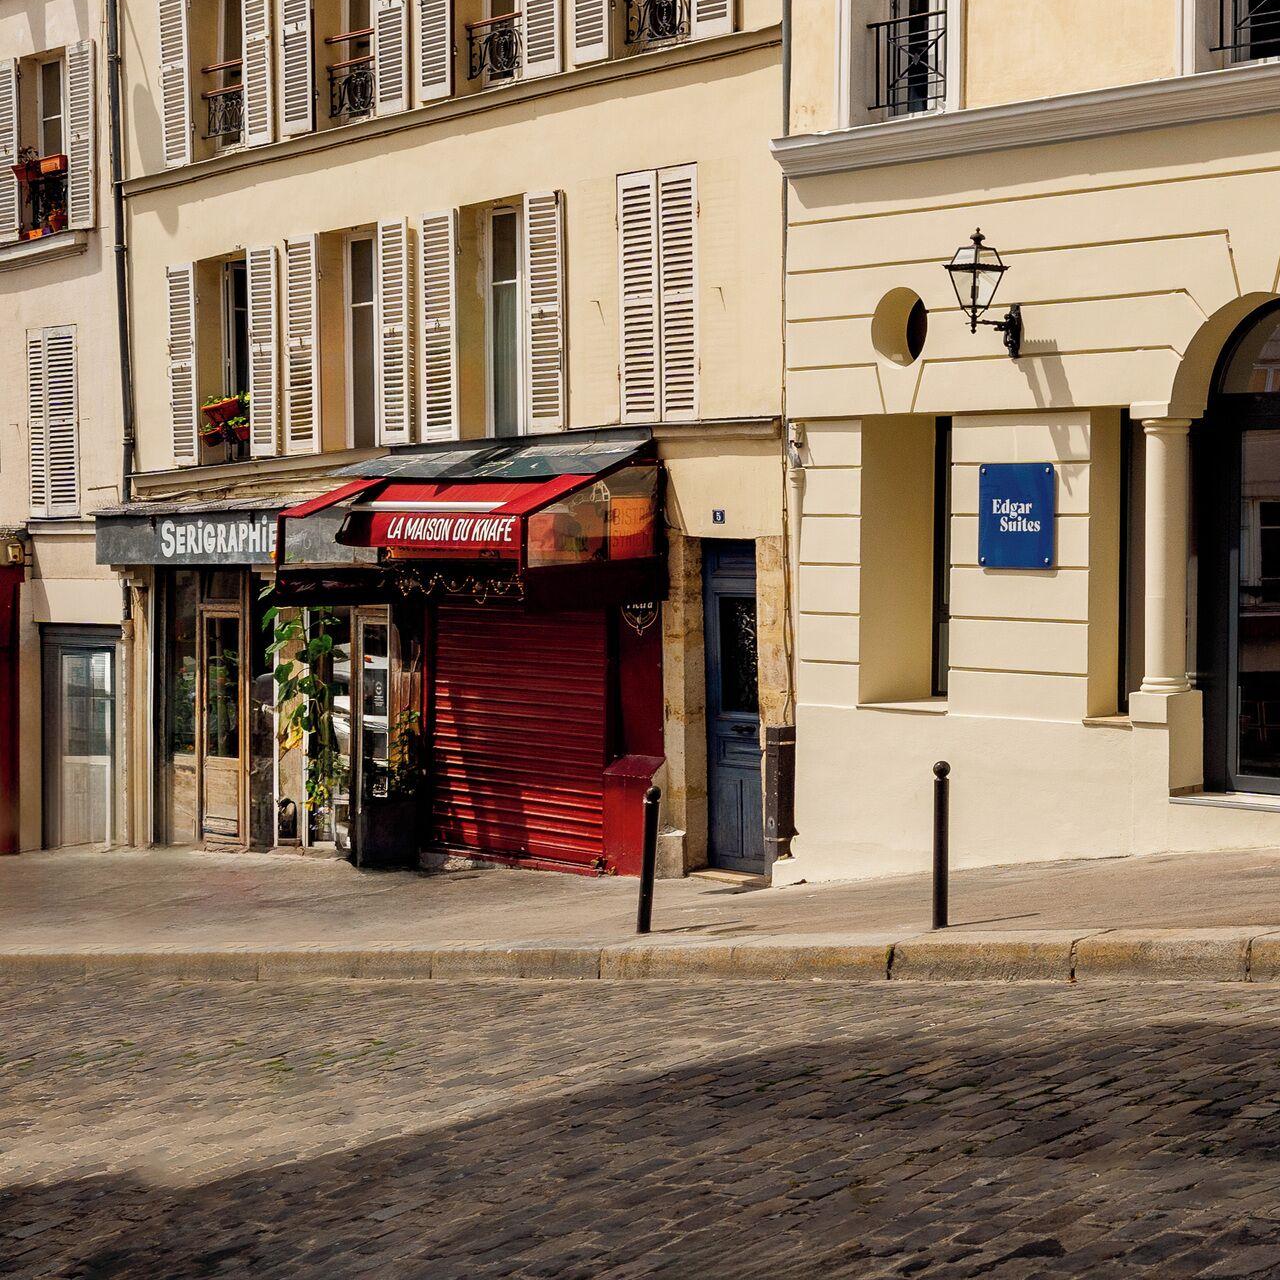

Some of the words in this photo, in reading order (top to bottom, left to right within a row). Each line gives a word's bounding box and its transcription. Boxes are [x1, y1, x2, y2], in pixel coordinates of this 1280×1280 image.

[992, 498, 1032, 518] Edgar
[387, 517, 405, 539] LA
[404, 517, 454, 541] MAISON
[452, 518, 473, 541] DU
[471, 515, 516, 542] KNAFÉ
[1000, 516, 1041, 532] Suites
